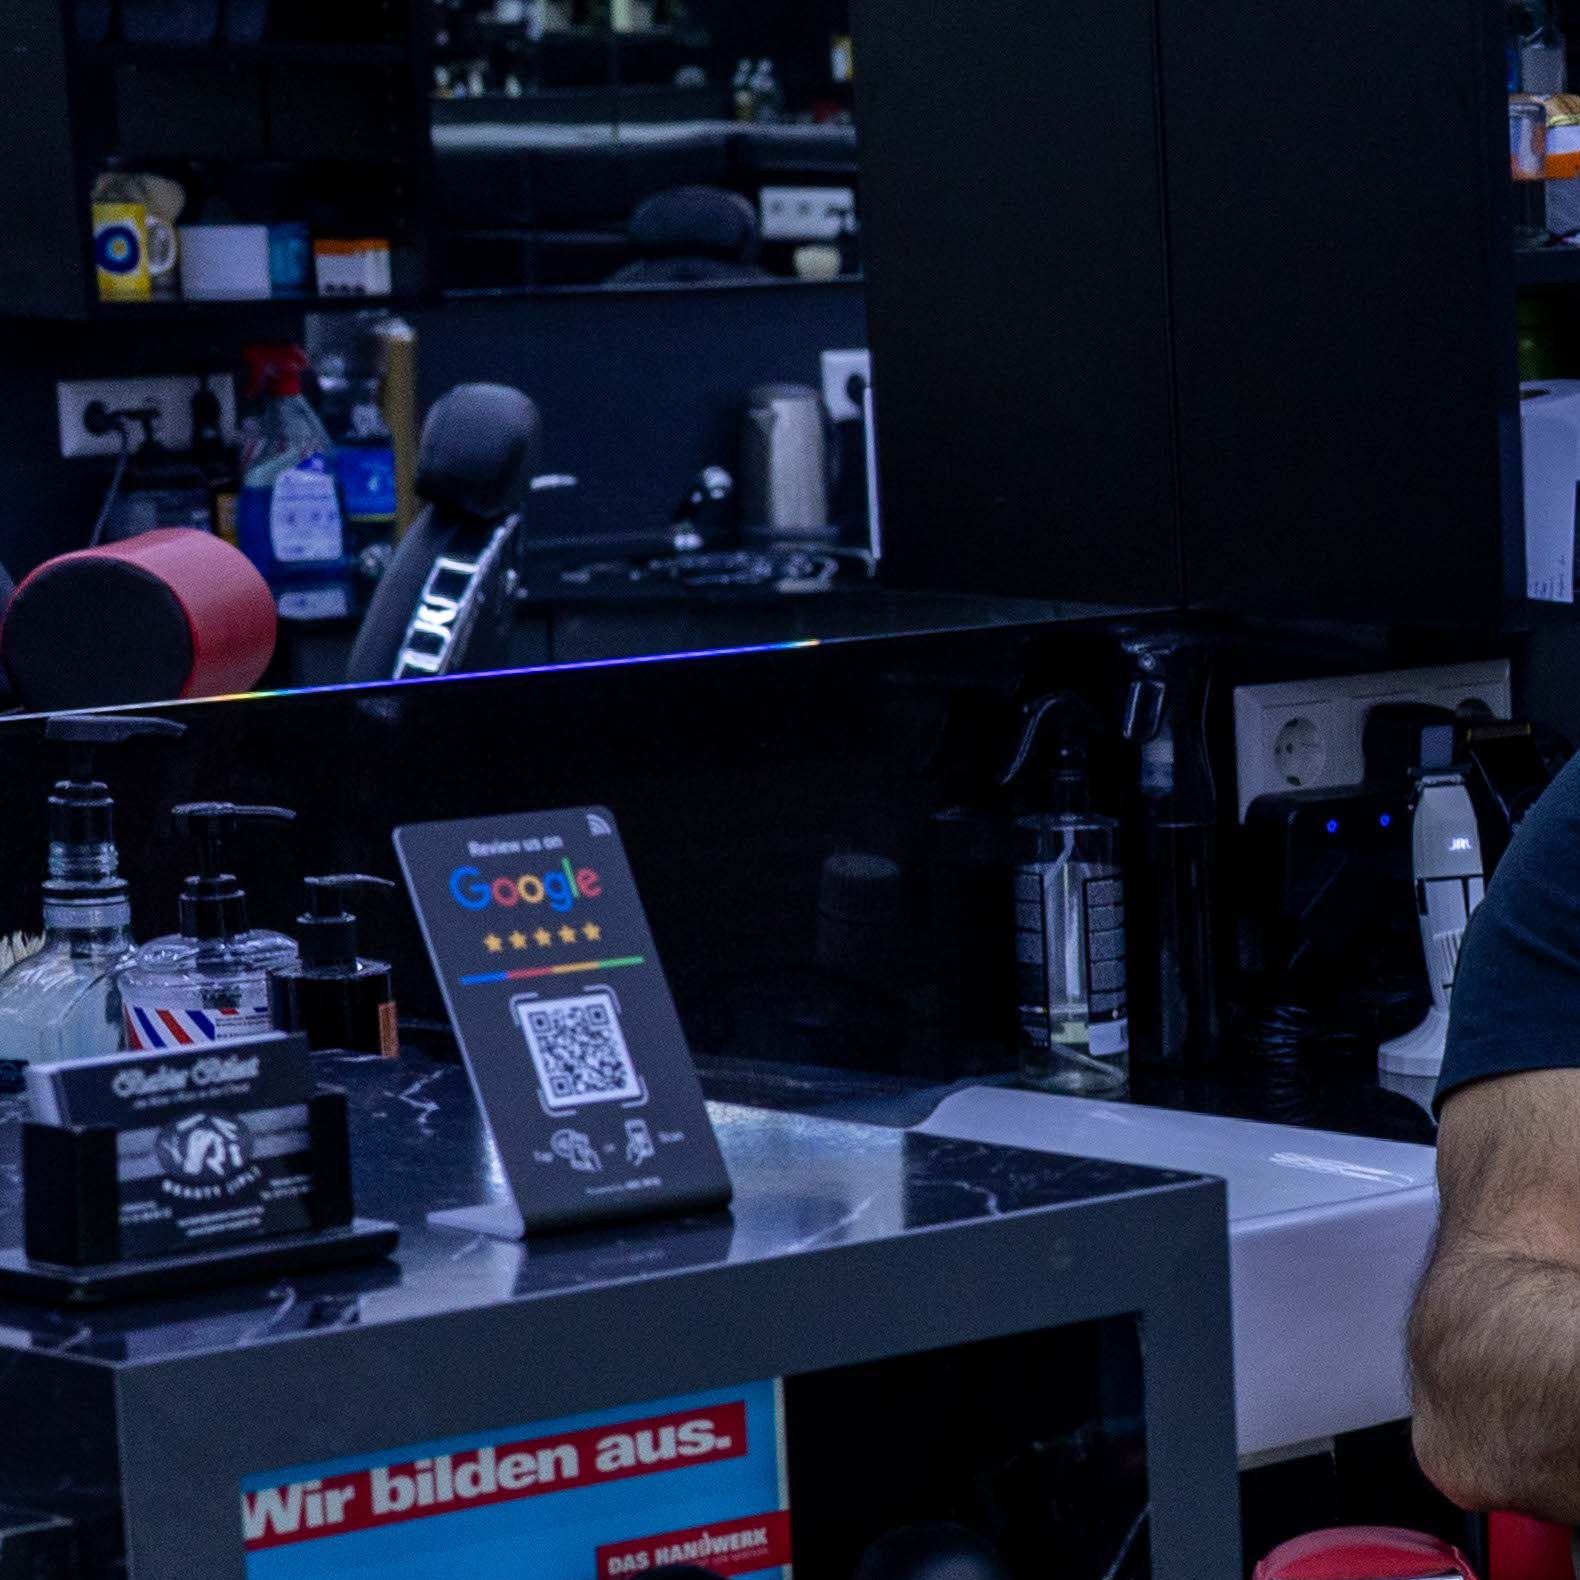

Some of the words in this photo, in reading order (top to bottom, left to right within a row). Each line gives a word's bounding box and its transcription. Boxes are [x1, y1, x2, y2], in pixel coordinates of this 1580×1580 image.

[450, 856, 603, 913] Google
[241, 1480, 357, 1542] Wir
[369, 1446, 580, 1516] bilden
[594, 1417, 732, 1473] aus.
[607, 1550, 650, 1577] DAS
[653, 1526, 769, 1567] HANDWERK
